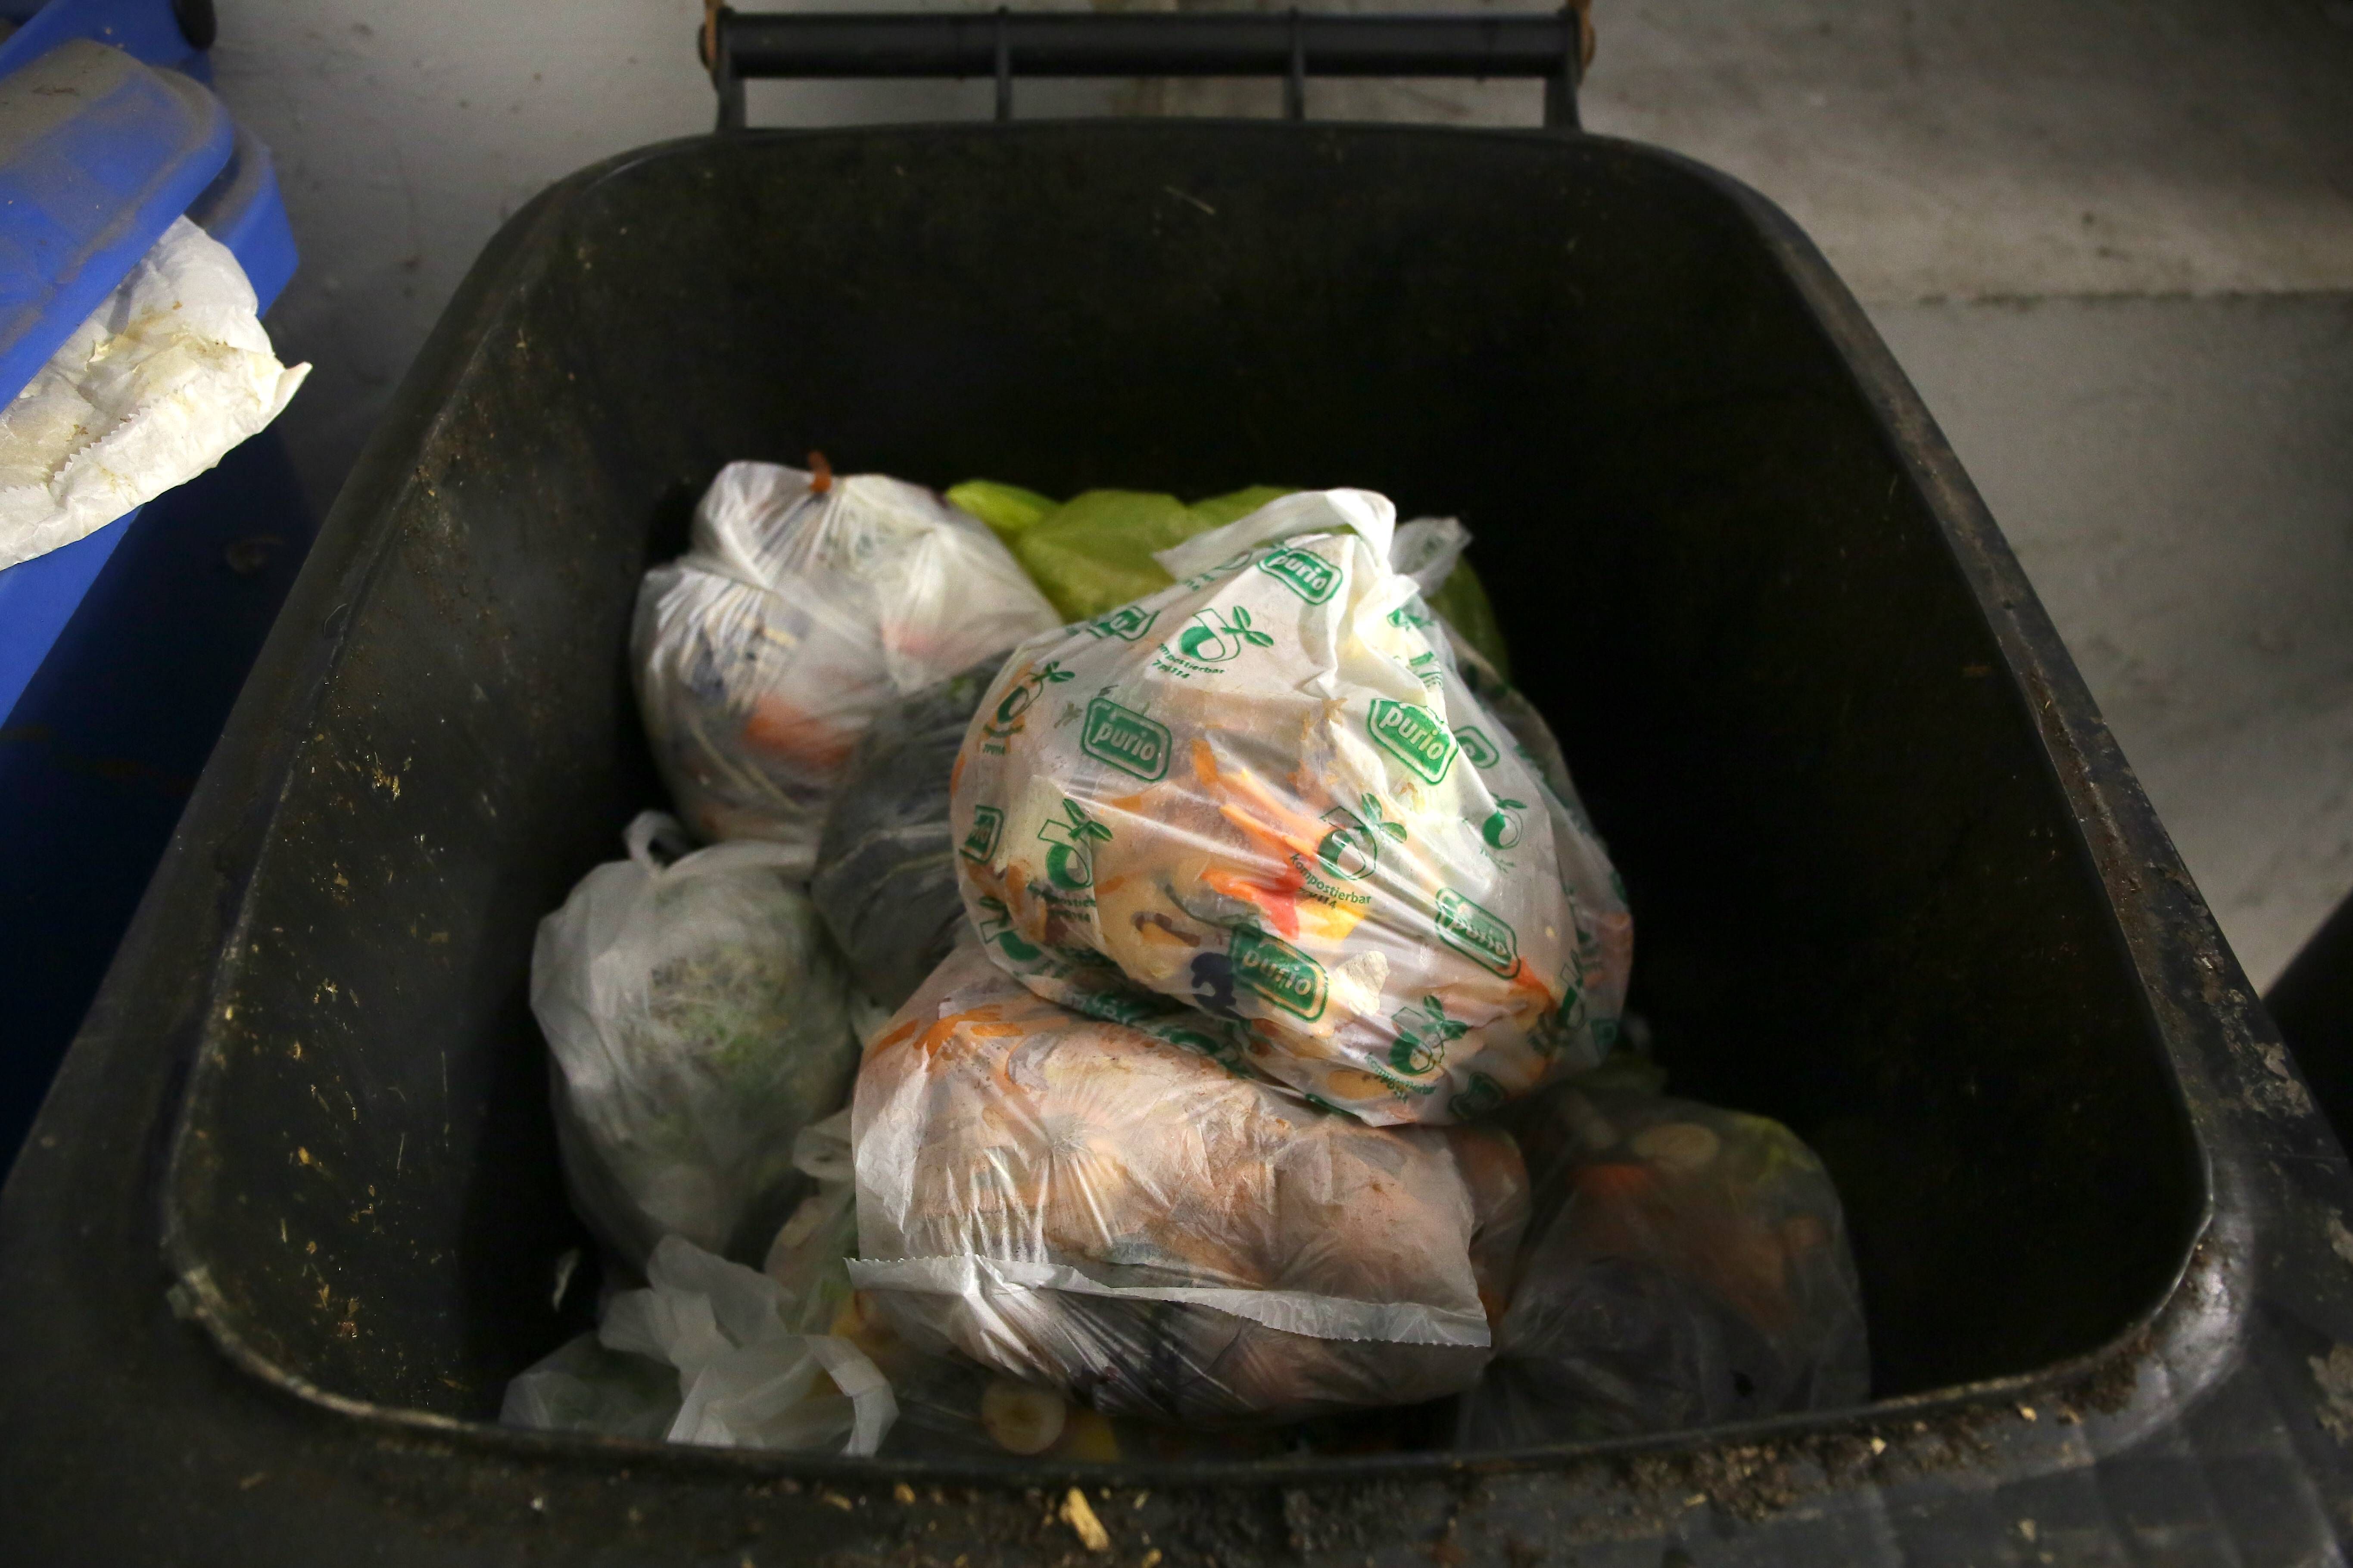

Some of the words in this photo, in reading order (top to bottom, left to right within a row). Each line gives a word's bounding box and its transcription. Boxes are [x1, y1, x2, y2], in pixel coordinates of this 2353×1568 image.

[1266, 555, 1327, 591] purio
[1091, 722, 1156, 761] purio
[1379, 706, 1444, 760] purio
[1290, 853, 1372, 904] kompostierbar
